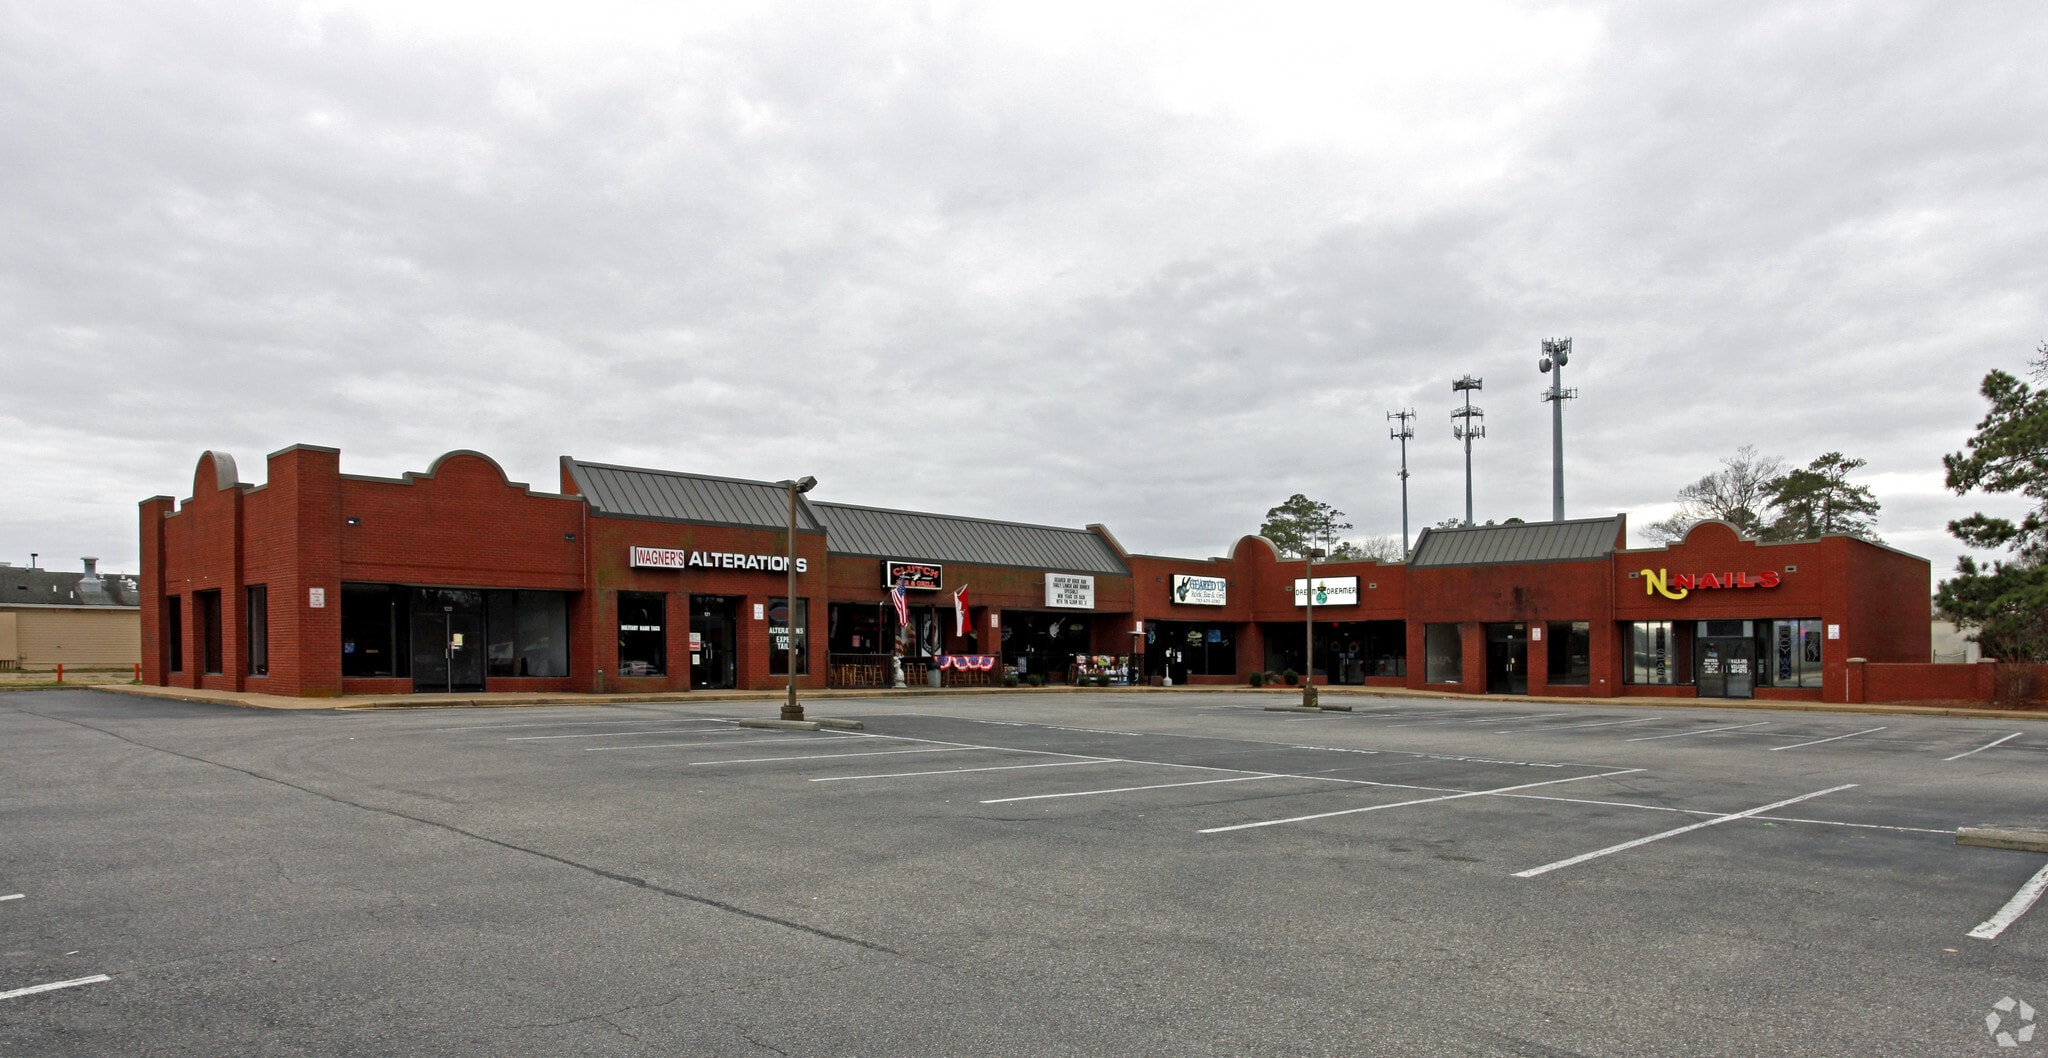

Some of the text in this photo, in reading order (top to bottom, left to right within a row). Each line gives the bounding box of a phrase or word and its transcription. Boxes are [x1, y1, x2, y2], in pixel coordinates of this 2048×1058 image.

[637, 549, 683, 566] WAGNER'S
[893, 565, 939, 578] CLUTCH
[1216, 581, 1226, 591] UP
[1641, 568, 1779, 600] N NAILS
[1327, 587, 1357, 595] DREAMER
